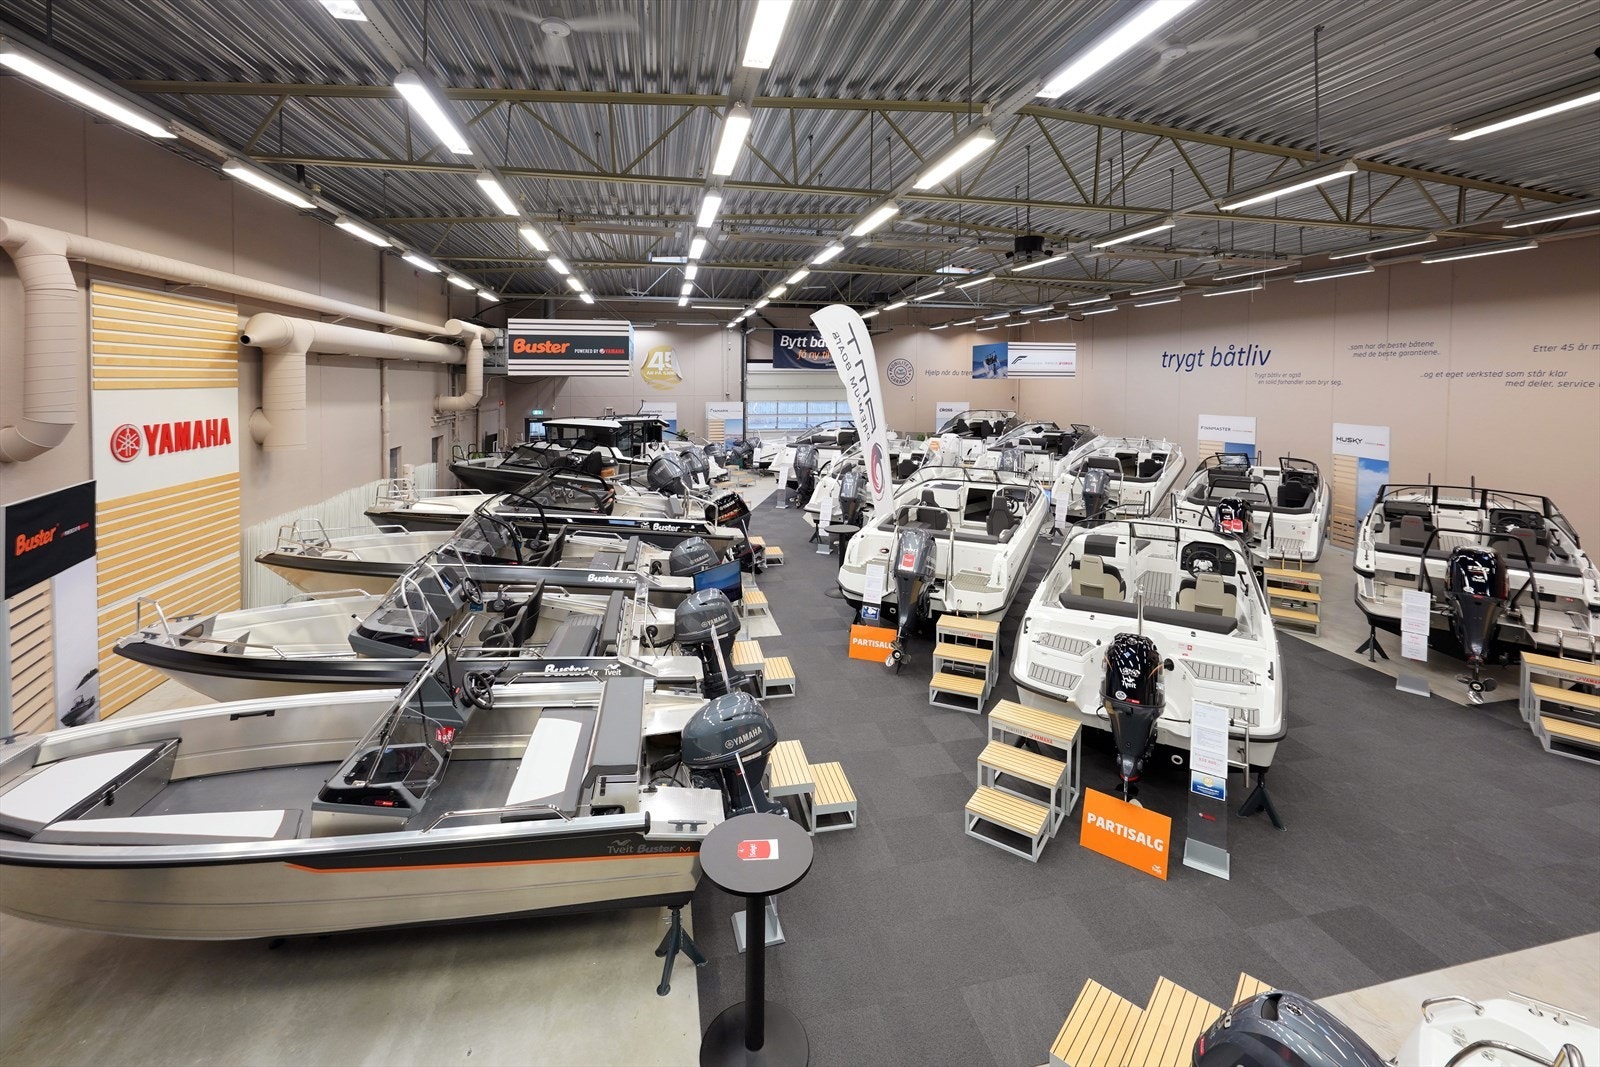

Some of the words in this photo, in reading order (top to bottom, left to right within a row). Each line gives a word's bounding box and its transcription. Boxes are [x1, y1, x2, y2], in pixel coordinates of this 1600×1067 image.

[513, 338, 570, 354] Buster
[780, 335, 808, 350] Bytt
[1387, 341, 1408, 349] beste
[1408, 340, 1435, 348] båtene
[1533, 344, 1558, 352] Etter
[1560, 343, 1575, 351] 45
[1577, 343, 1589, 351] år
[808, 351, 820, 361] ny
[1162, 351, 1205, 372] trygt
[1210, 344, 1272, 367] båtliv
[925, 369, 941, 377] Hjelp
[1445, 371, 1464, 379] eget
[1466, 370, 1504, 378] verksted
[1527, 369, 1547, 378] står
[1549, 370, 1568, 378] klar
[890, 375, 910, 384] GARANTI
[1557, 379, 1596, 388] service
[143, 417, 232, 457] YAMAHA
[1335, 436, 1363, 445] HUSKY
[652, 522, 681, 532] Buster
[15, 527, 57, 556] Buster
[587, 573, 620, 583] Buster
[604, 668, 622, 676] Tveit
[733, 726, 763, 746] YAMAHA
[1087, 812, 1164, 852] PARTISALG
[607, 845, 634, 854] Tveit
[637, 843, 676, 853] Buster
